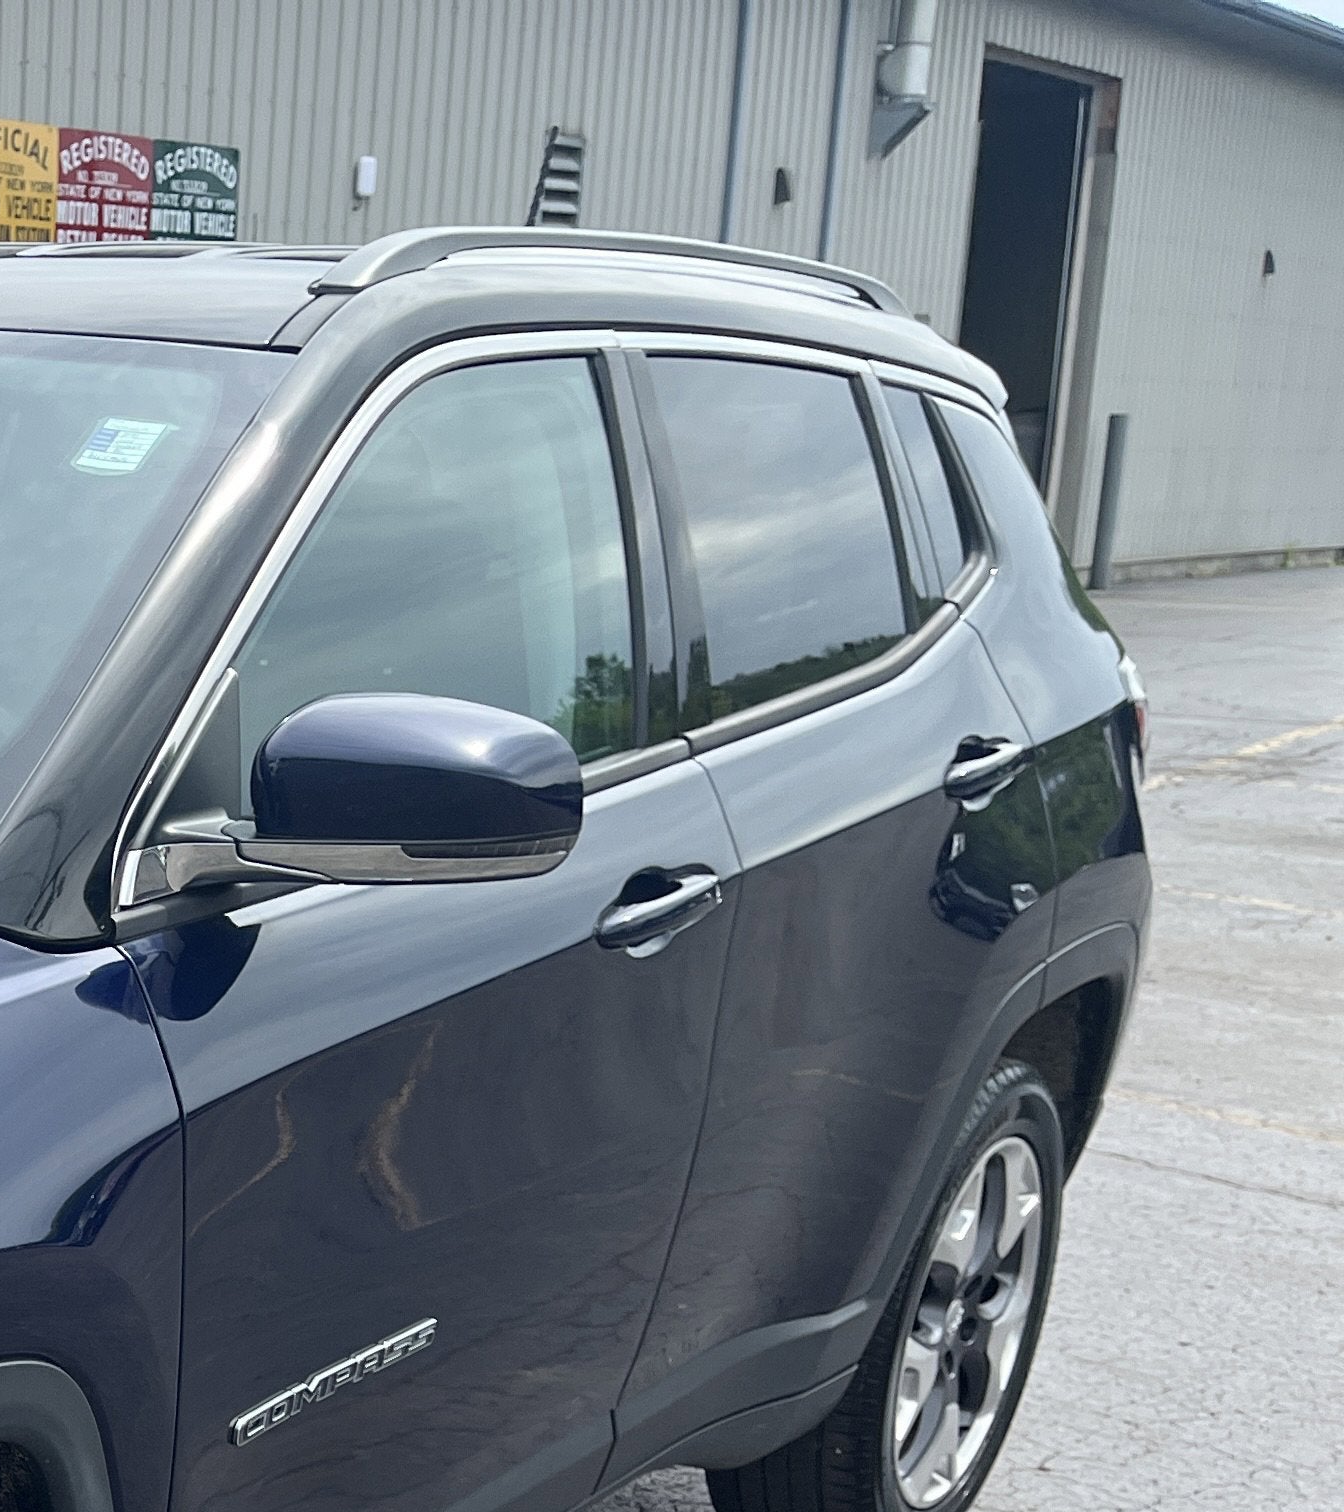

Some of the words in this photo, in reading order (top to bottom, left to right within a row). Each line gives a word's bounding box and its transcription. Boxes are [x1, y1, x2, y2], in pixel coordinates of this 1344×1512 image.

[59, 134, 150, 181] REGISTERED
[154, 145, 237, 189] REGISTERED
[6, 177, 25, 191] NEW
[58, 182, 87, 199] STATE
[88, 185, 102, 200] OF
[6, 194, 52, 222] VEHICLE
[56, 199, 99, 227] MOTOR
[102, 203, 149, 231] VEHICLE
[150, 207, 192, 235] MOTOR
[193, 210, 236, 238] VEHICLE
[227, 1317, 438, 1447] COMPASS
